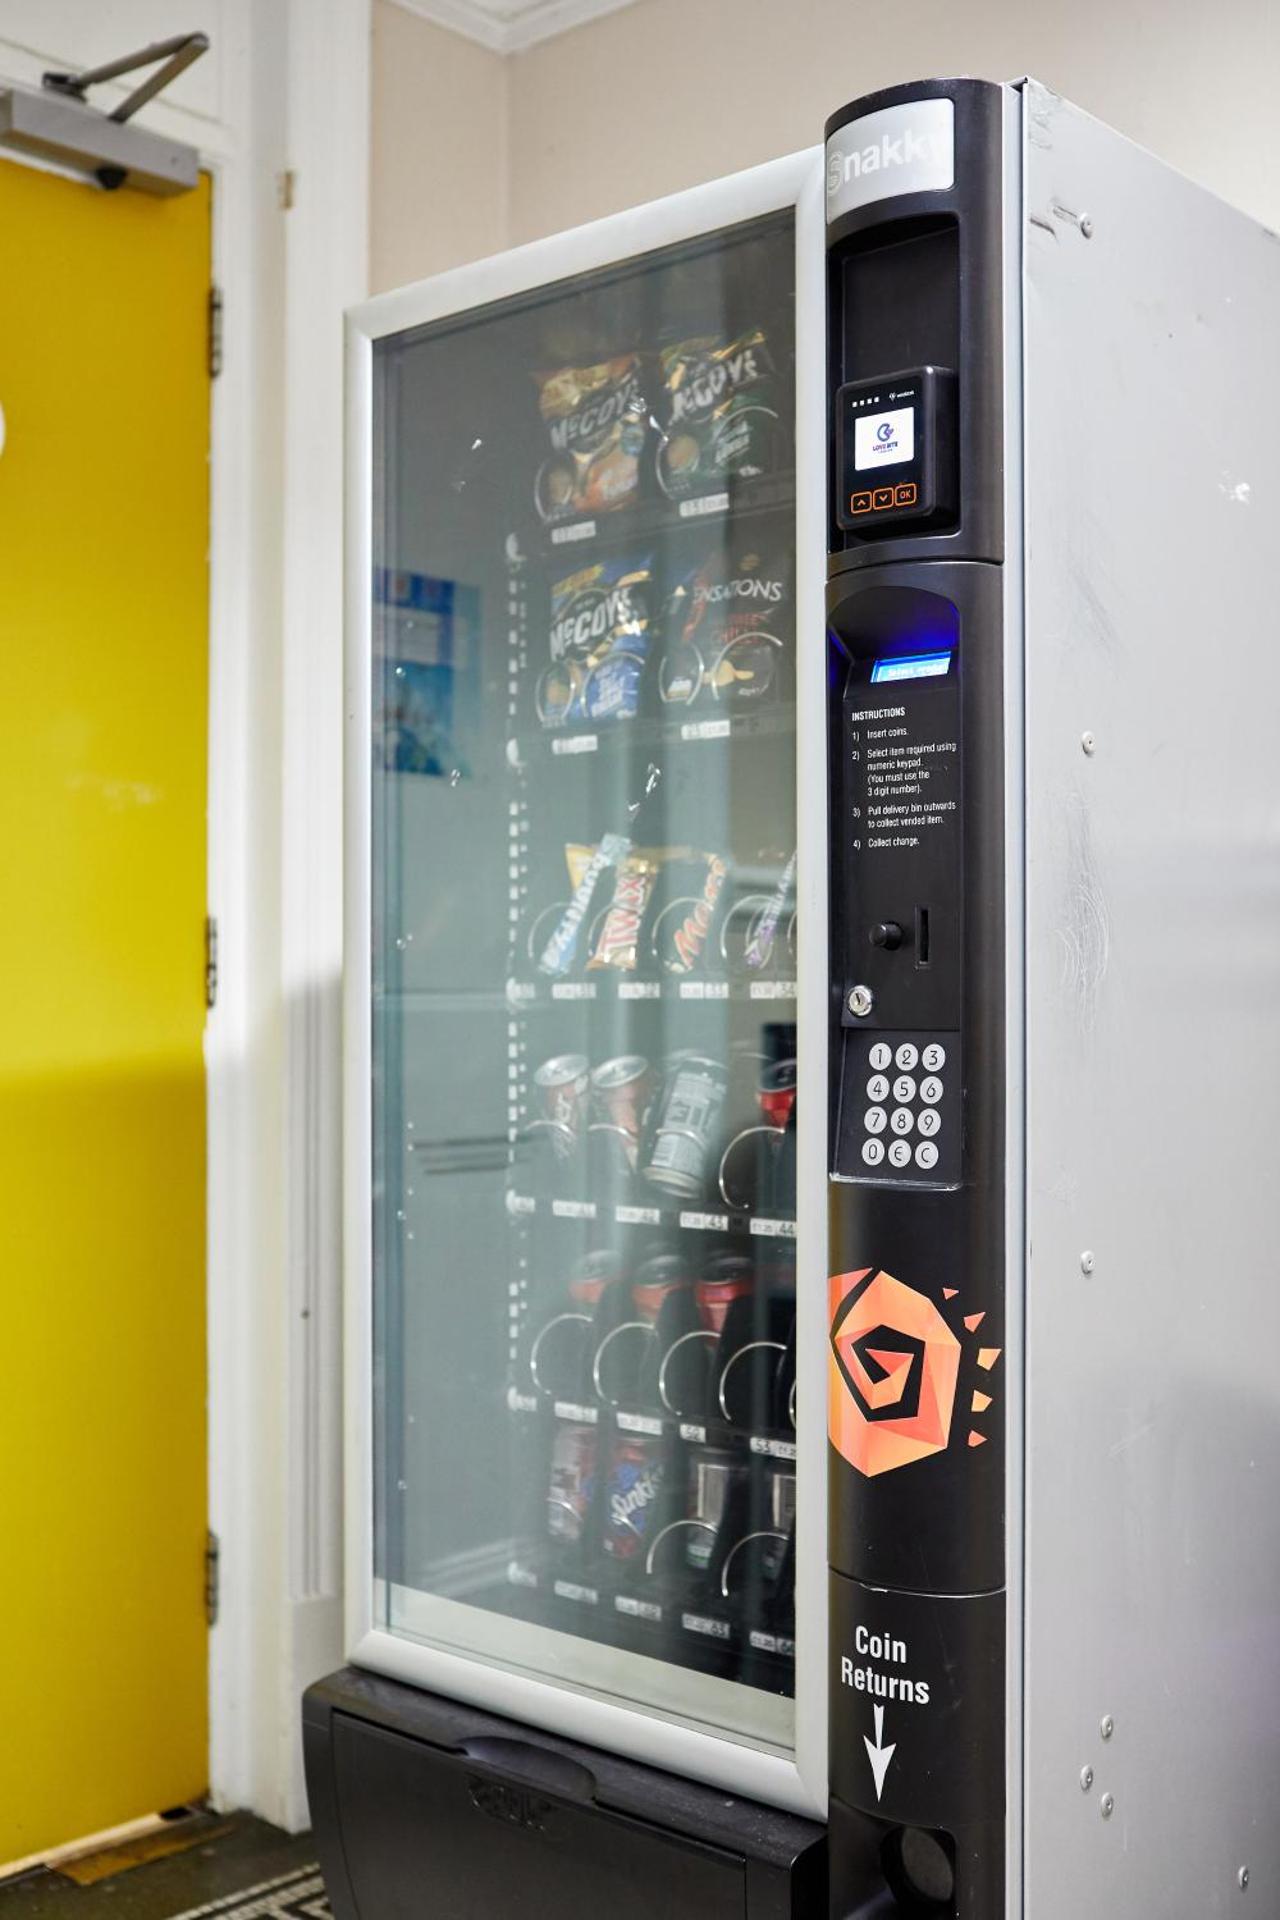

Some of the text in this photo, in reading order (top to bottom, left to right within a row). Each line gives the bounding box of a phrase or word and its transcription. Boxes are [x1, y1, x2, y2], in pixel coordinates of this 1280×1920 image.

[900, 489, 911, 499] OK
[852, 706, 905, 721] INSTRUCTIONS
[852, 731, 860, 742] 1)
[867, 729, 887, 739] Insert
[852, 742, 957, 760] 2) Select item required using
[867, 760, 895, 771] numeric
[868, 770, 930, 785] (You must use the
[867, 786, 873, 797] 3
[874, 786, 889, 797] digit
[853, 800, 956, 818] 3) Pull delivery bin outwards
[868, 820, 875, 829] to
[876, 818, 900, 828] collect
[900, 816, 926, 826] vended
[853, 840, 861, 850] 4)
[868, 838, 892, 848] Collect
[878, 1049, 938, 1066] 1 2 3
[873, 1080, 936, 1098] 4 5 6
[872, 1112, 934, 1131] 7 8 9
[868, 1144, 878, 1160] 0
[921, 1148, 930, 1163] C
[856, 1625, 906, 1663] Coin
[842, 1656, 930, 1704] Returns
